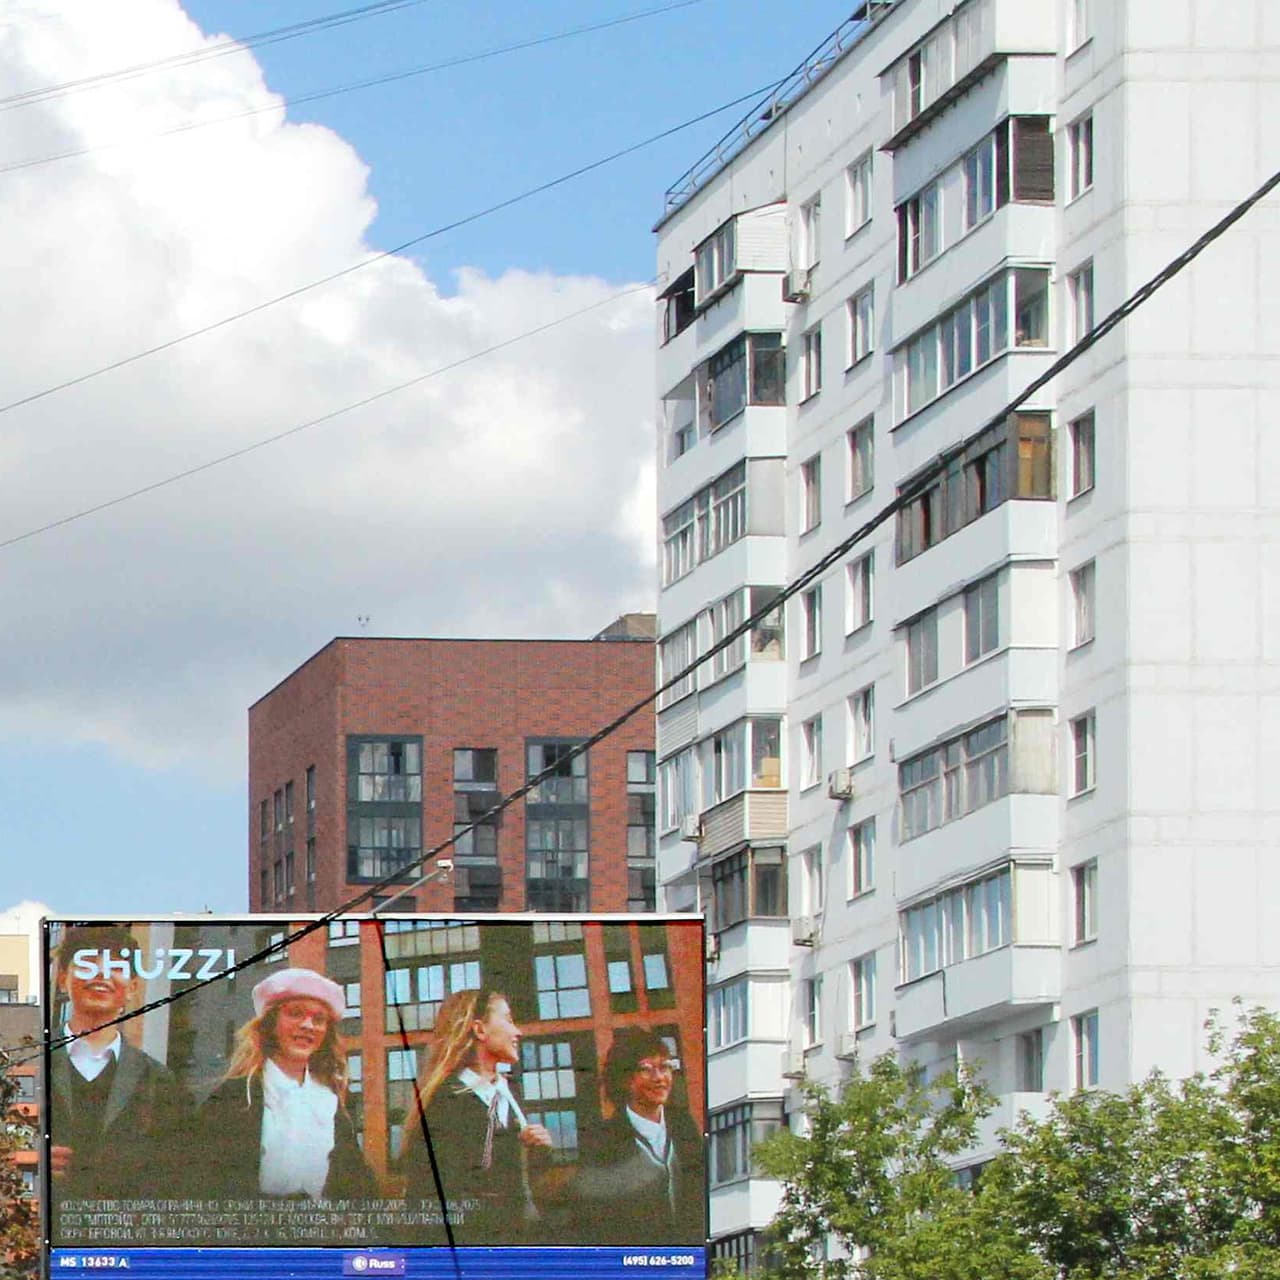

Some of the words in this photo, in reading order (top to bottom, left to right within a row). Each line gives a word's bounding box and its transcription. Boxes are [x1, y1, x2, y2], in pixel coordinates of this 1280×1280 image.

[59, 1257, 76, 1268] MS
[81, 1256, 116, 1268] 13633
[368, 1257, 396, 1269] Russ
[648, 1255, 695, 1266] 626-5200
